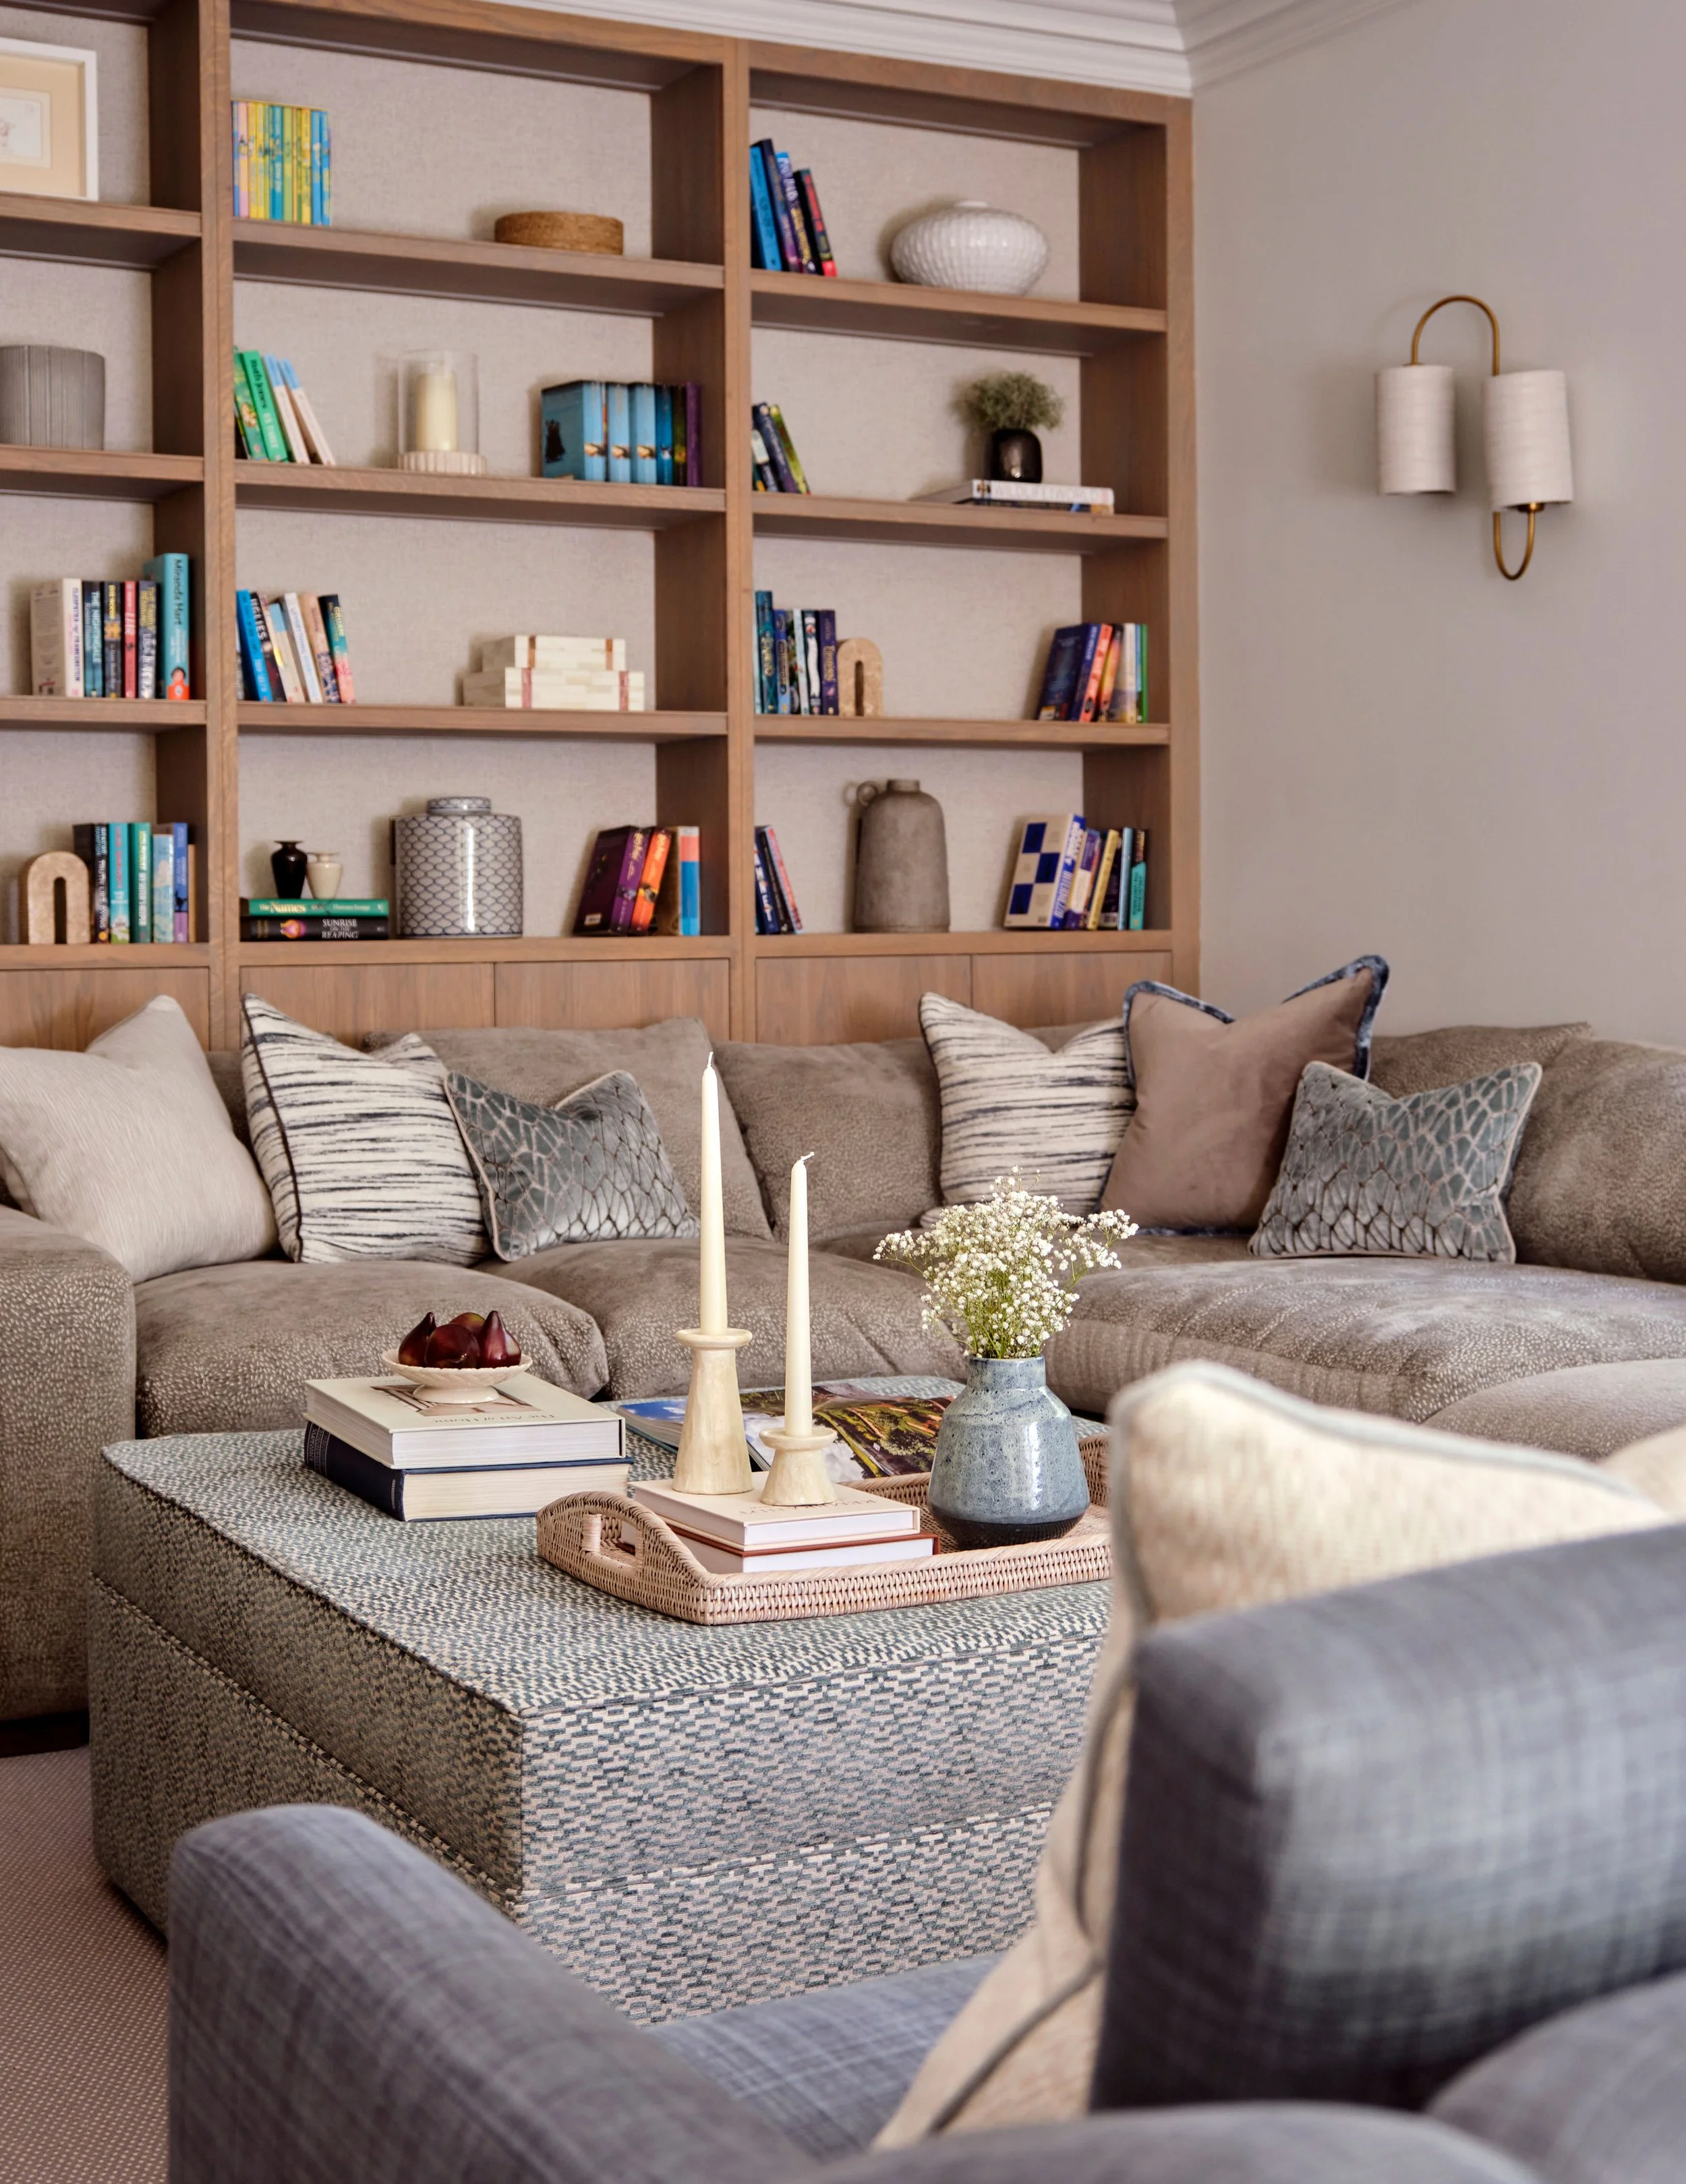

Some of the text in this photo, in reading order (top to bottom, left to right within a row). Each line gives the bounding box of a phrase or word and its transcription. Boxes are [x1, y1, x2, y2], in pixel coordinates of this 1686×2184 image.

[174, 559, 183, 599] Miranda
[91, 591, 100, 606] THE
[175, 602, 183, 625] Hart
[270, 902, 306, 914] Names
[322, 919, 357, 927] SUNRISE
[322, 931, 359, 939] REAPING
